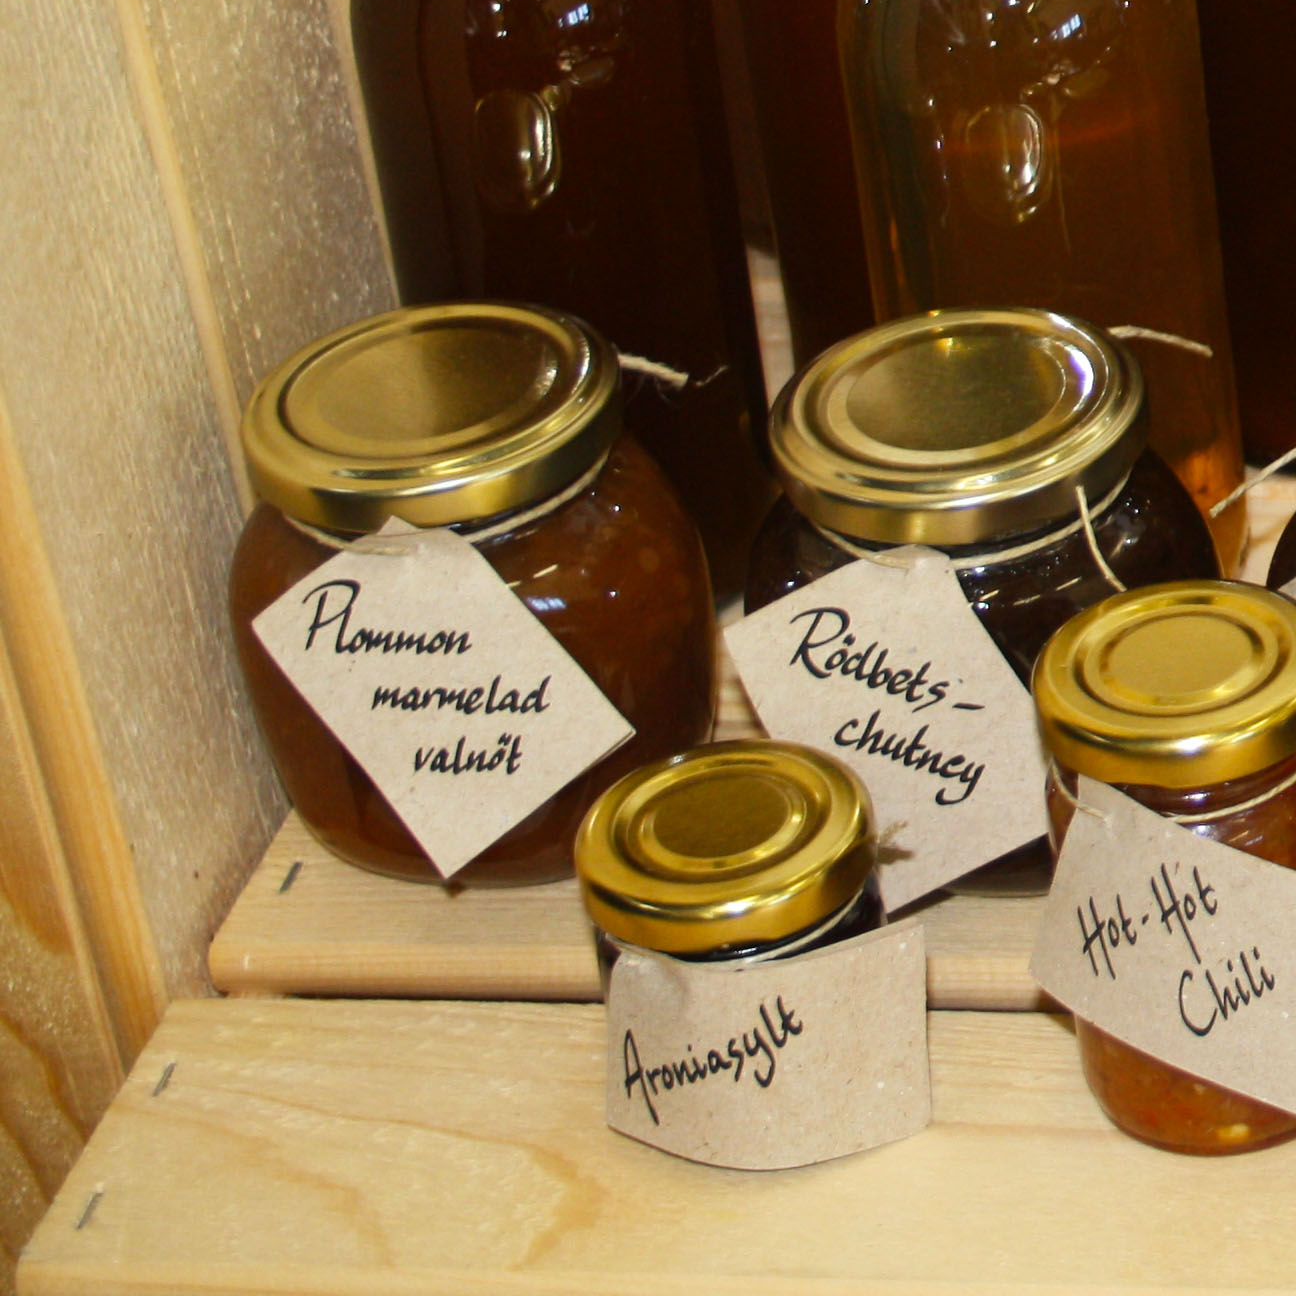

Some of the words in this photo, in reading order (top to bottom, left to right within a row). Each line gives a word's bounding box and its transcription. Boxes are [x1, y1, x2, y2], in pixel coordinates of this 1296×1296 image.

[302, 579, 471, 657] Plommon
[371, 675, 551, 714] marmelad
[414, 733, 522, 775] valnöt
[834, 713, 987, 805] chutney
[1176, 947, 1276, 1037] Chili
[625, 995, 803, 1126] Aroniasylt
